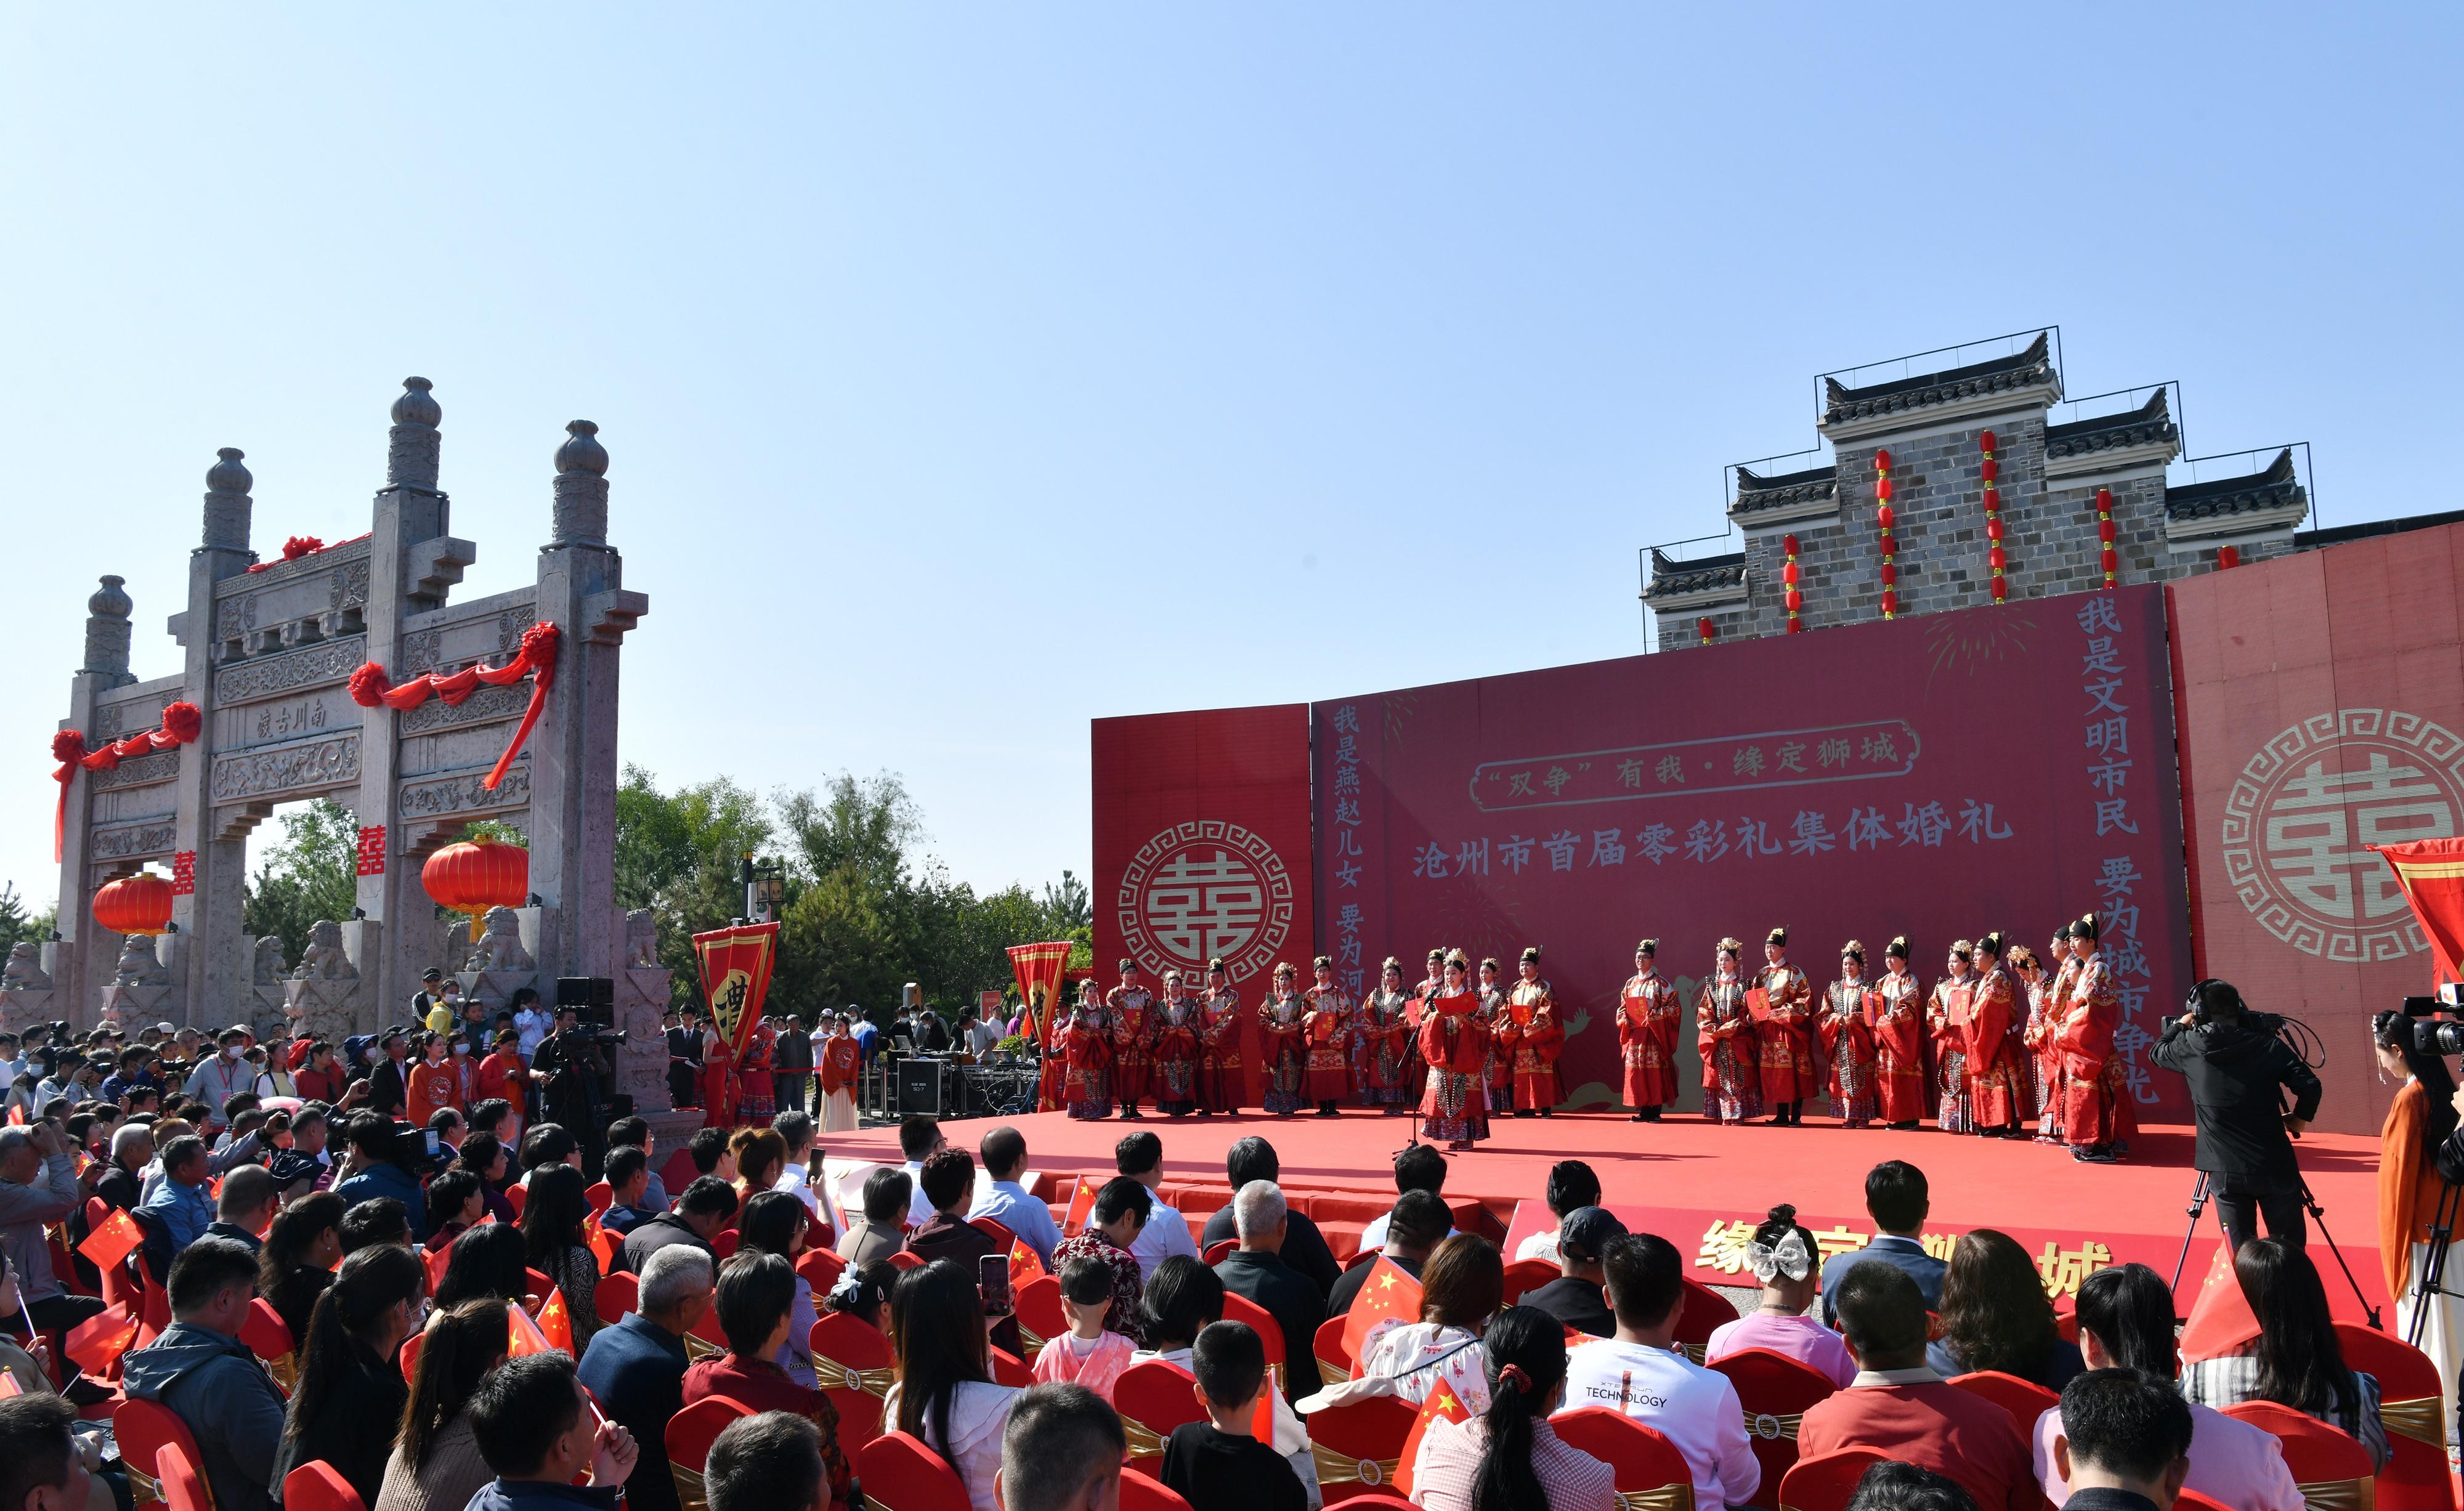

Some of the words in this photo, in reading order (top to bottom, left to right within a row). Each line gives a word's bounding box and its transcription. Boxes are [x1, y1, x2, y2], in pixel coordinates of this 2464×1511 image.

[2076, 596, 2139, 837] 我是文明市民
[1333, 704, 1363, 889] 我是燕赵儿女
[1412, 798, 2014, 880] 沧州市首届零彩礼集体婚礼
[1586, 1386, 1668, 1408] TECHNOLOGY
